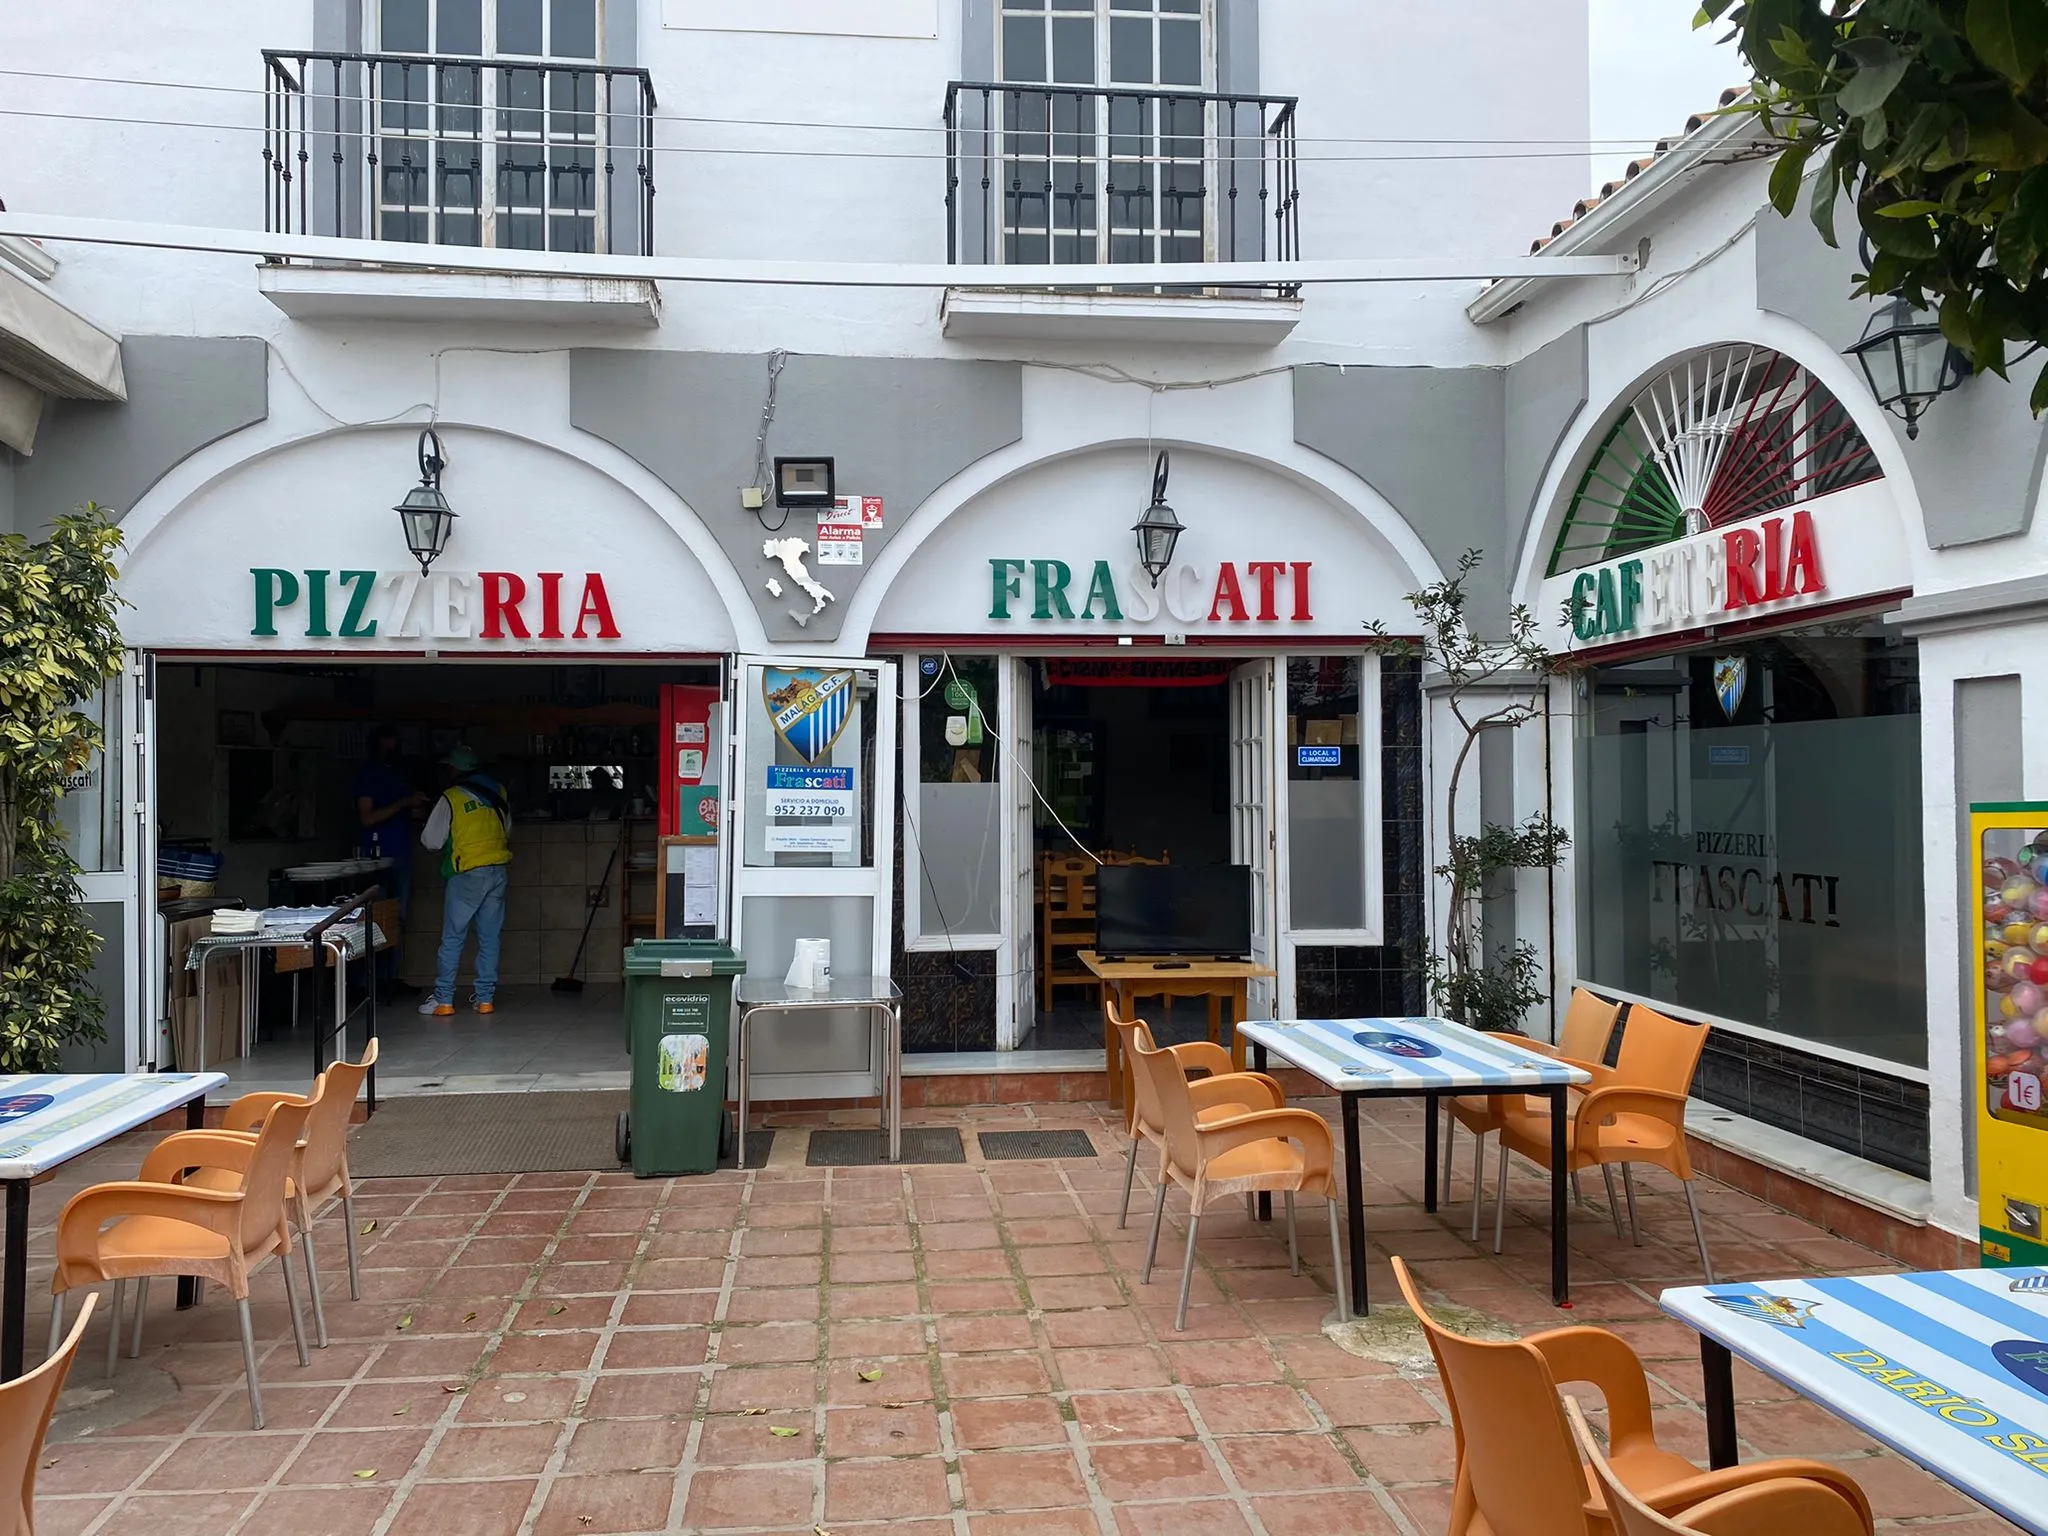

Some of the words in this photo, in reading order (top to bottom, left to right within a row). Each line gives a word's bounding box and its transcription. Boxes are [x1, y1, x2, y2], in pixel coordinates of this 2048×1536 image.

[820, 526, 861, 535] Alarma
[1571, 509, 1827, 641] CAFETERIA
[988, 558, 1314, 621] FRASCATI
[250, 568, 622, 639] PIZZERIA
[774, 771, 847, 789] Frascati
[774, 805, 796, 815] 952
[799, 805, 821, 816] 237
[823, 806, 846, 816] 090
[1696, 831, 1779, 858] PIZZERIA
